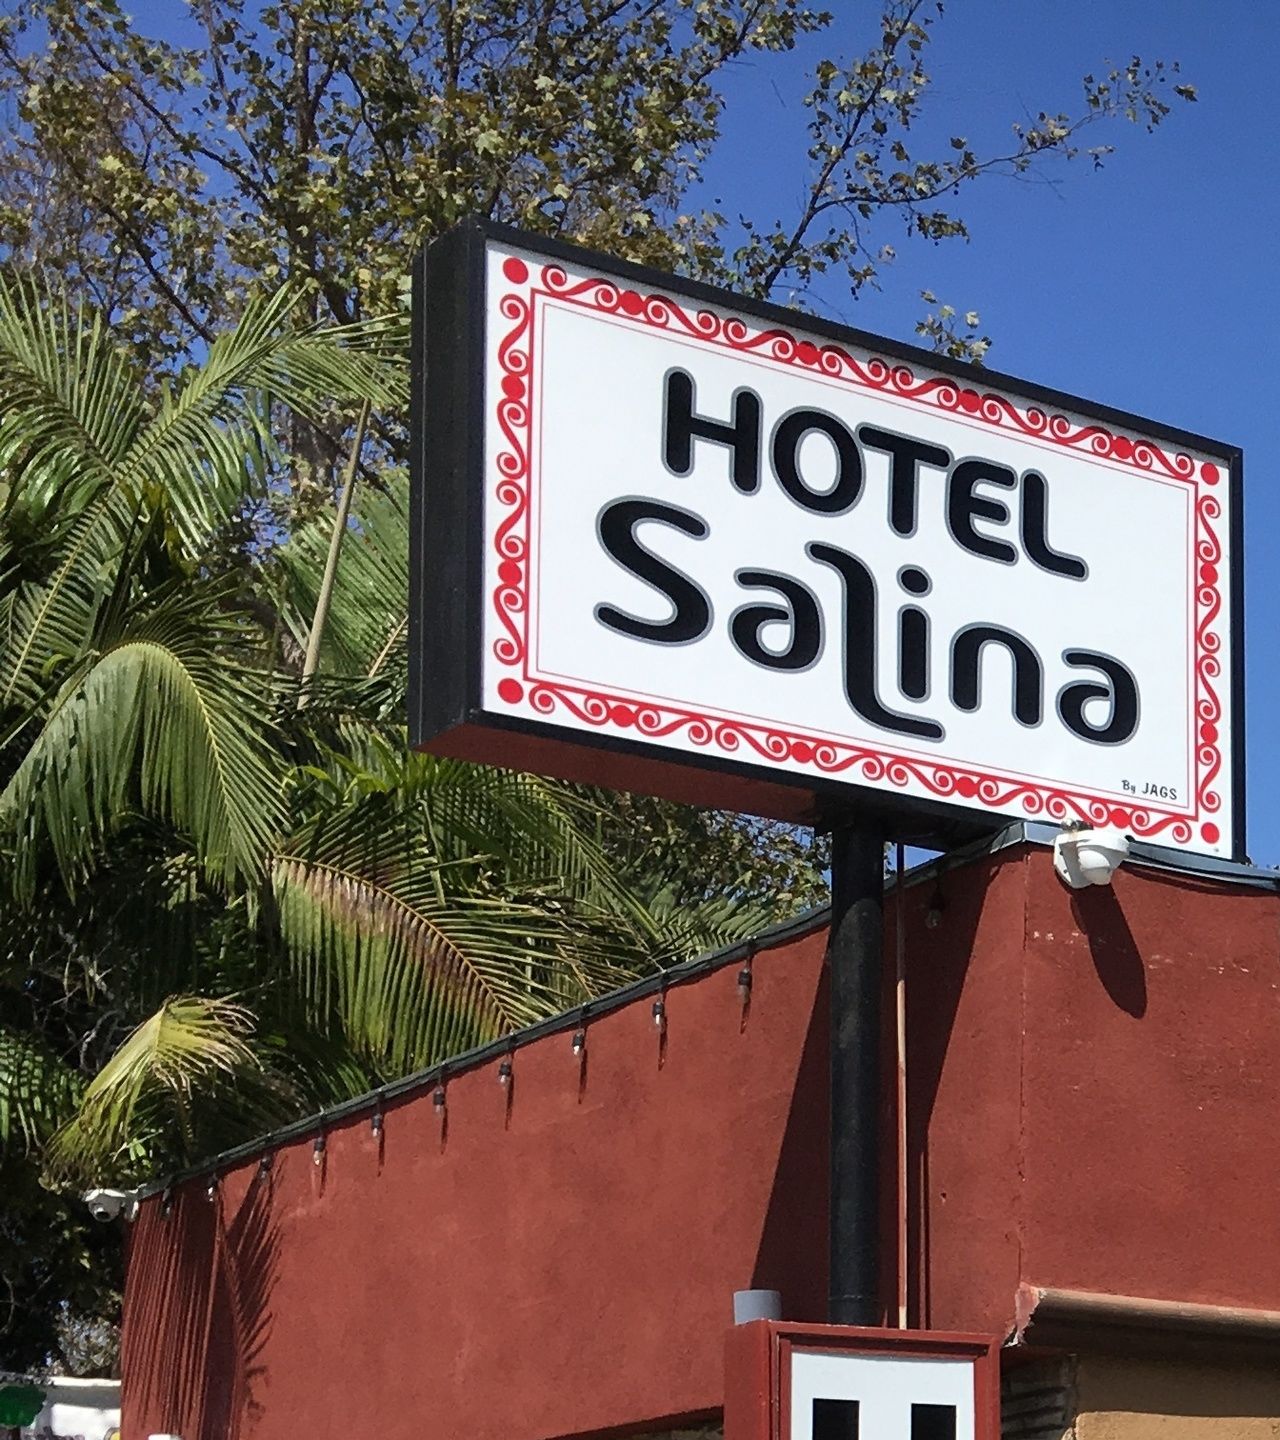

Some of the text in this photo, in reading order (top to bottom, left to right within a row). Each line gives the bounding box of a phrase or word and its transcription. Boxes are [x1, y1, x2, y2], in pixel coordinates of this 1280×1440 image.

[661, 366, 1090, 582] HOTEL
[593, 495, 1142, 748] Salina
[1121, 779, 1178, 800] By JAGS
